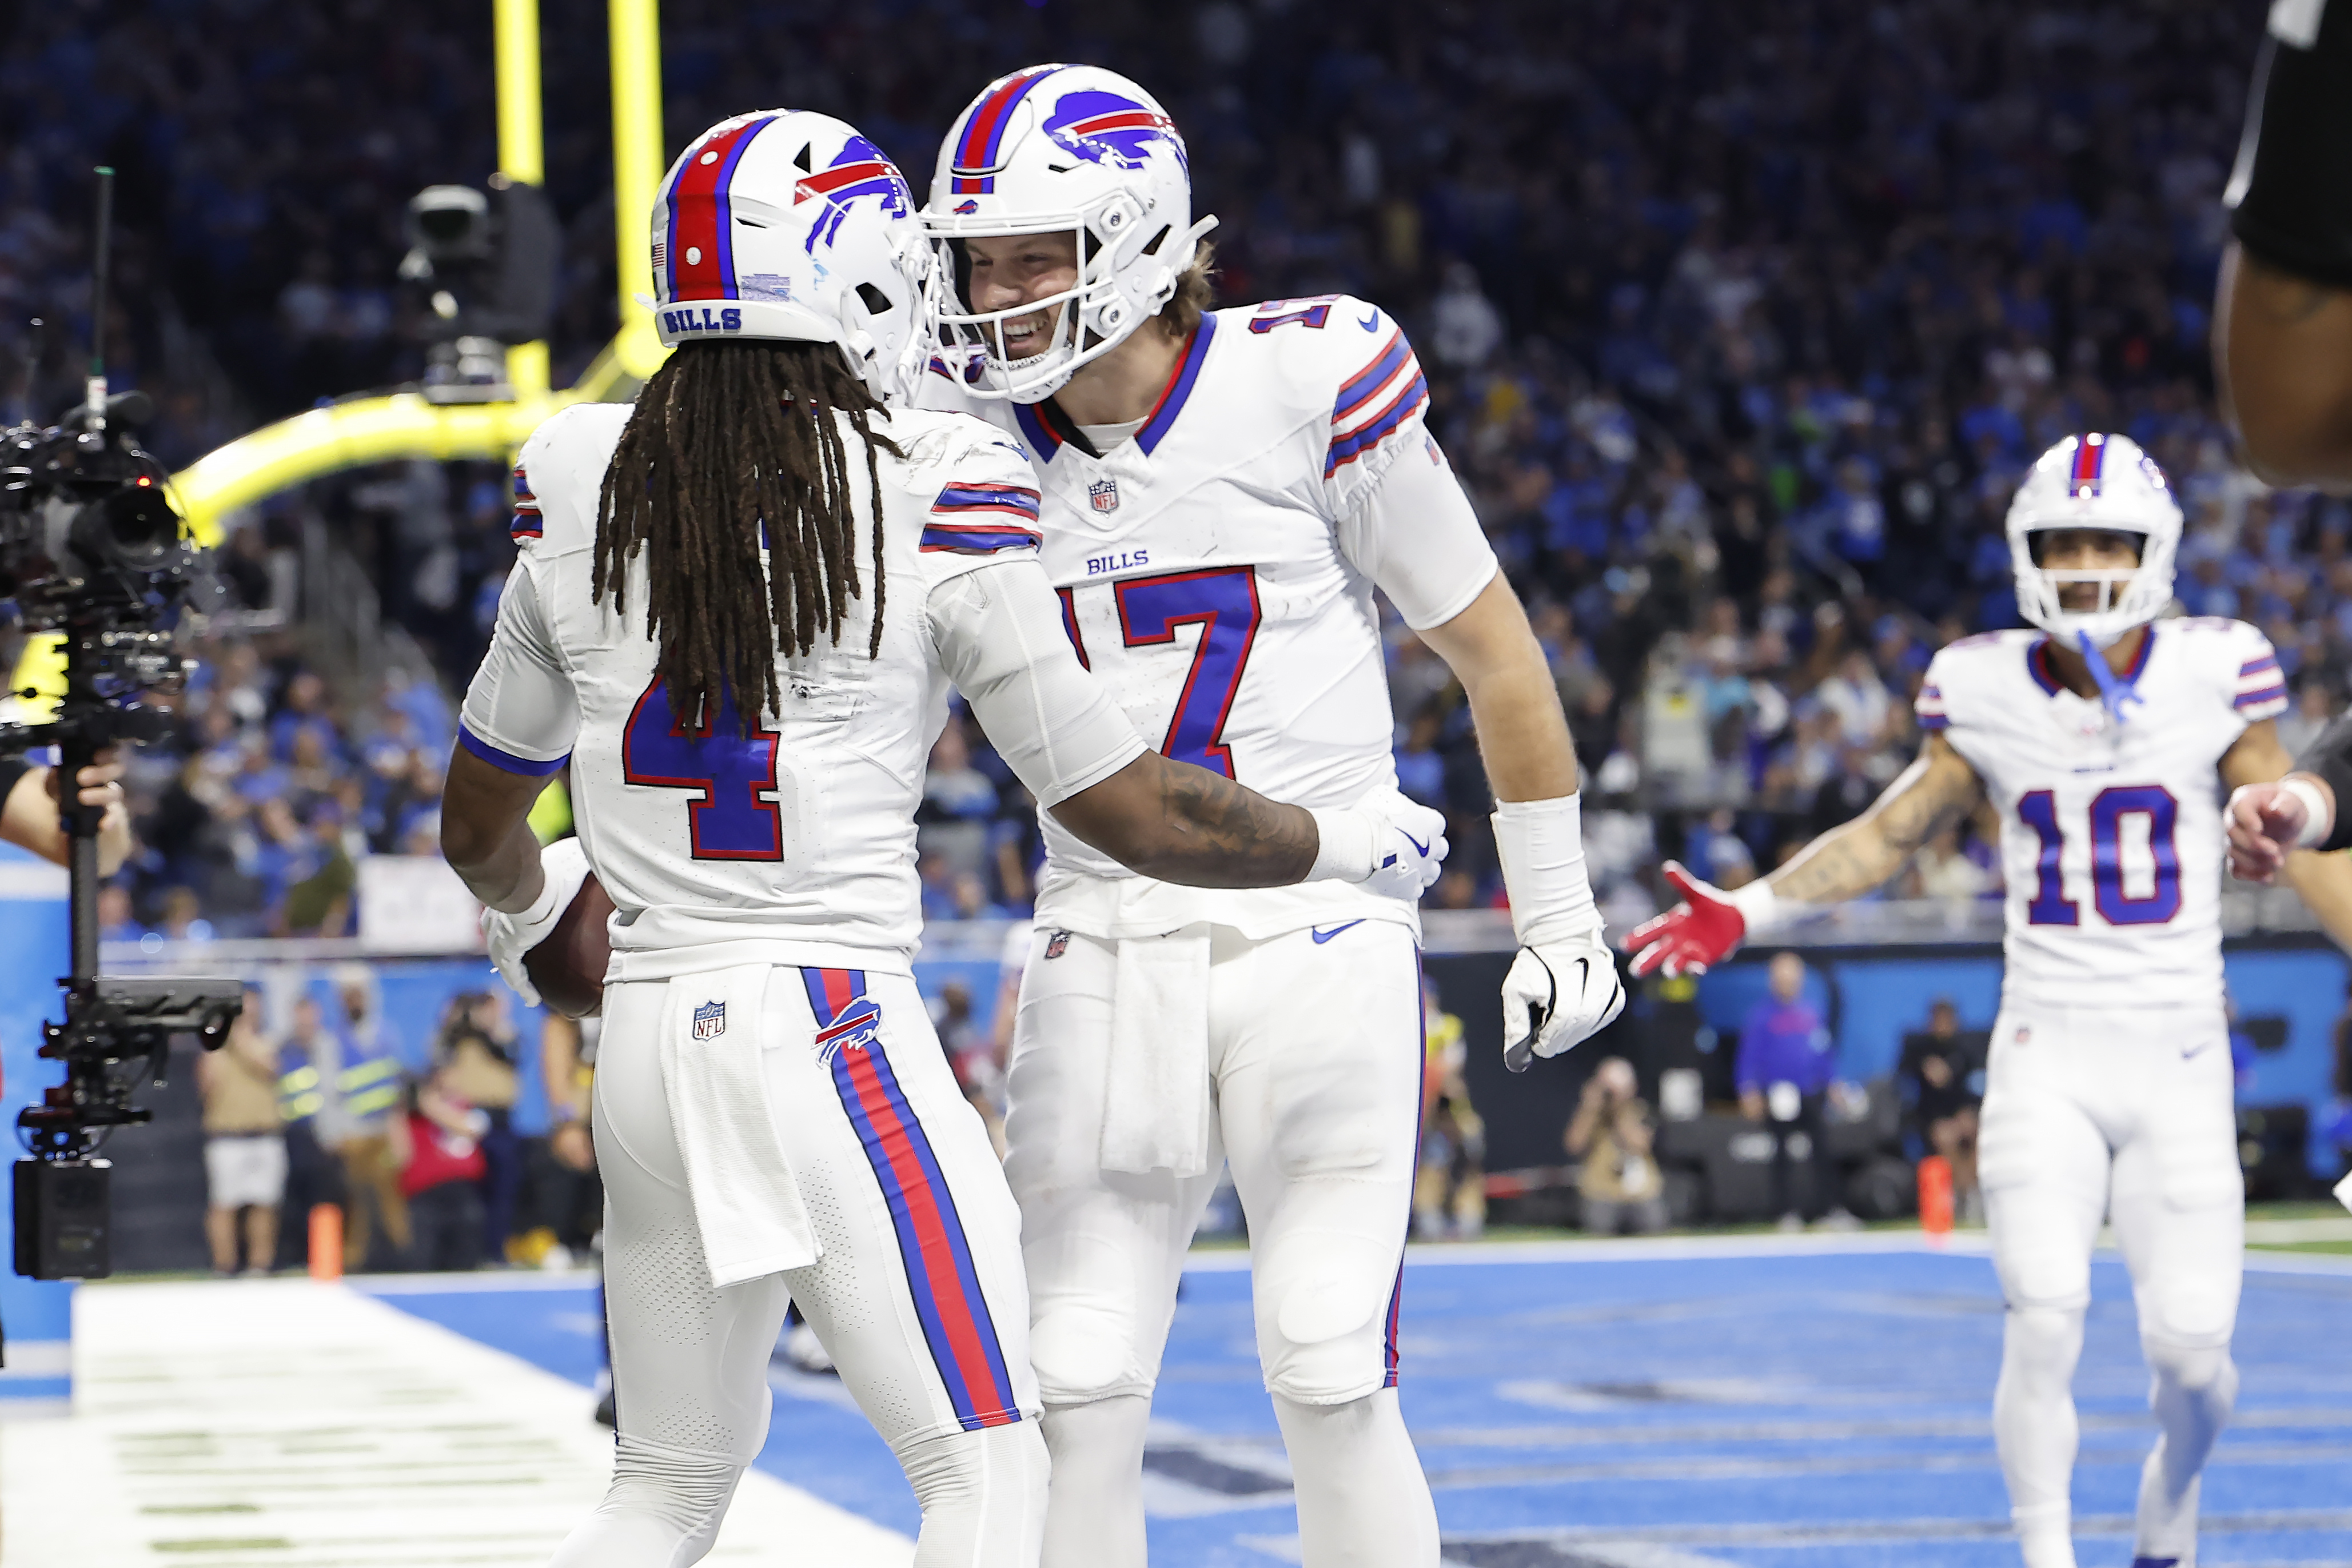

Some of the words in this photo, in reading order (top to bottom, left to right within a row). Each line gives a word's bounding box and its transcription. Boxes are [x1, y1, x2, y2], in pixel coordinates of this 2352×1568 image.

[664, 308, 742, 333] BILLS
[1094, 493, 1115, 509] NFL
[1087, 549, 1149, 575] BILLS
[622, 657, 784, 861] 4
[2018, 784, 2184, 925] 10
[696, 1018, 721, 1036] NFL
